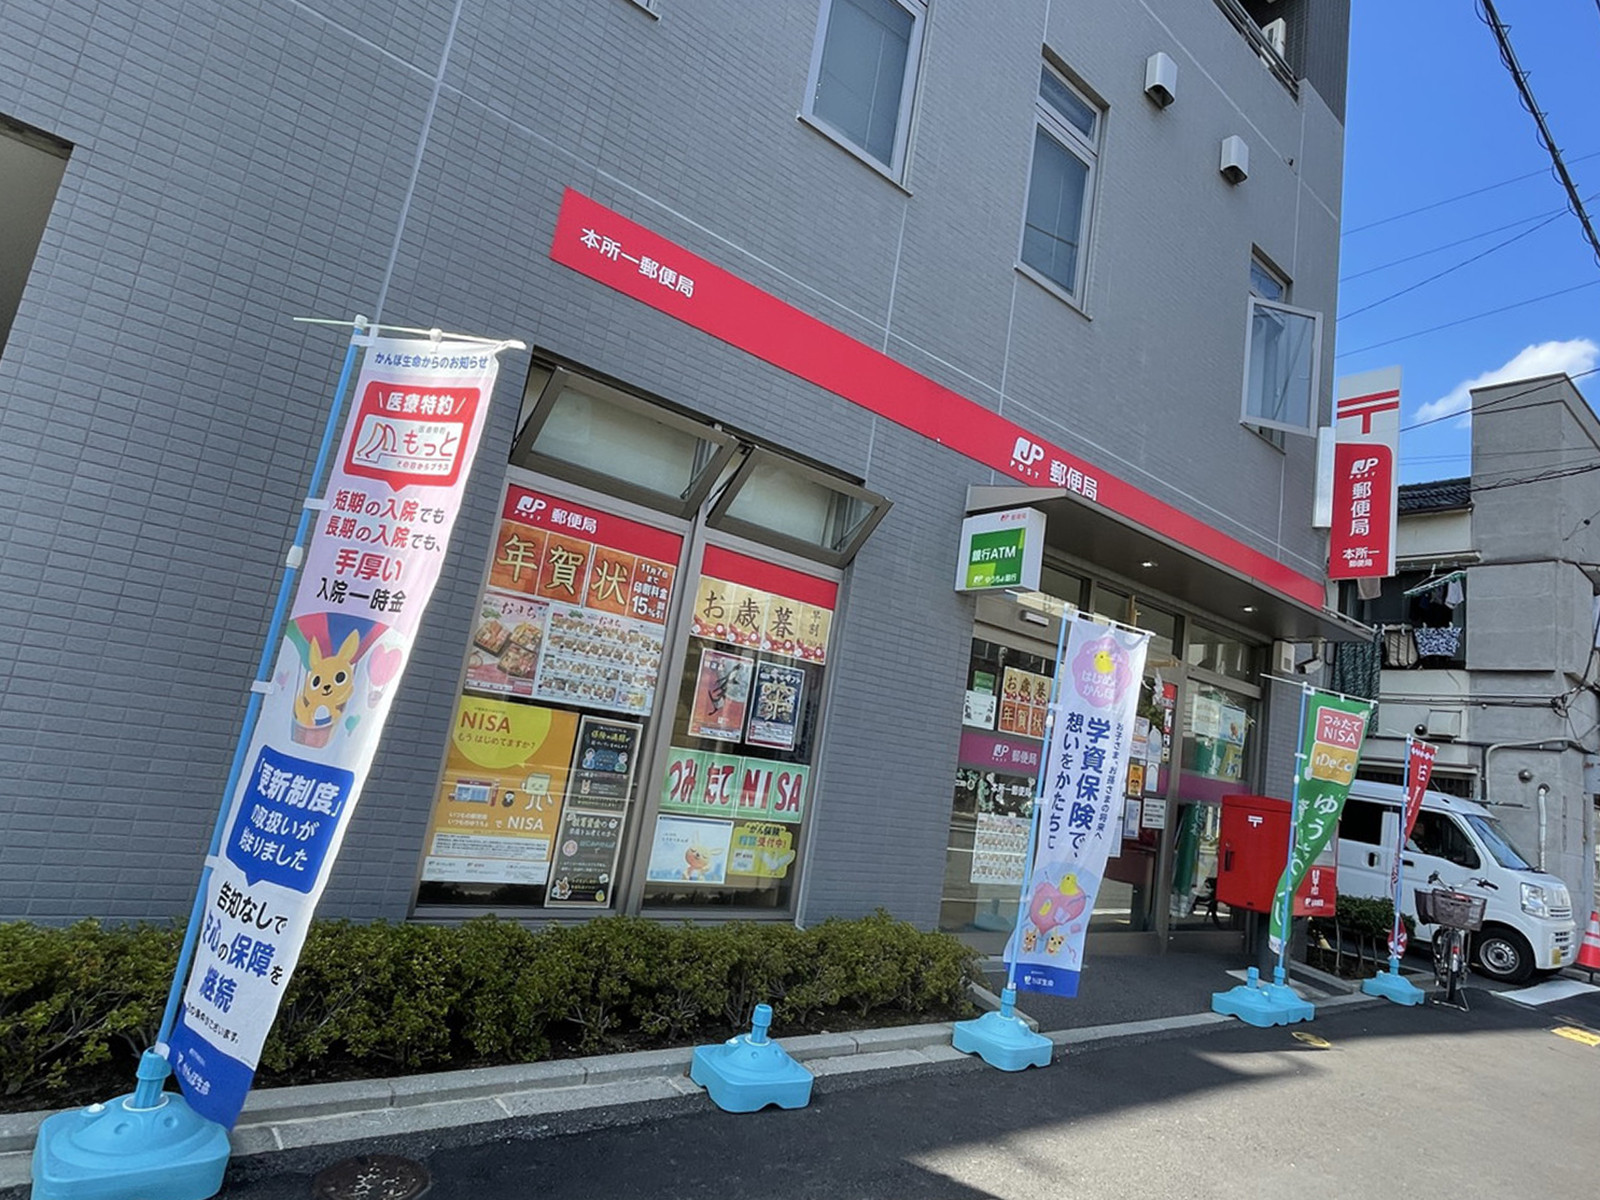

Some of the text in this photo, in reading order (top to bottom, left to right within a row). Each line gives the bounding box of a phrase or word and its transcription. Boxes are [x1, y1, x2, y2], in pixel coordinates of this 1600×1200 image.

[579, 227, 695, 298] 本所一郵便局
[374, 352, 488, 369] かんぽ生命からのお知らせ
[386, 391, 454, 415] 医療特約
[403, 429, 457, 456] もっと
[1009, 460, 1040, 479] POST
[1049, 459, 1098, 501] 郵便局
[333, 489, 444, 523] 短期の入院でも
[1350, 481, 1372, 536] 郵便局
[324, 515, 442, 552] 長期の入院でも、
[550, 508, 597, 534] 郵便局
[335, 548, 402, 581] 手厚い
[971, 545, 1016, 562] 銀行ATM
[1343, 547, 1380, 559] 本所一
[496, 533, 628, 606] 年賀状
[316, 577, 407, 613] 入院一時金
[634, 581, 668, 600] 印刷料金
[703, 590, 794, 639] お歳暮
[460, 711, 511, 734] NISA
[1002, 706, 1043, 732] 年賀状
[1323, 715, 1362, 732] つみたて
[1323, 726, 1357, 745] NISA
[1012, 750, 1037, 766] 郵便局
[1316, 753, 1353, 772] iDeCo
[258, 757, 342, 817] 「更新制度」
[1047, 712, 1085, 849] 想いをかたちに
[1068, 716, 1111, 858] 学資保険で、
[507, 815, 543, 831] NISA
[217, 881, 288, 935] 告知なしで
[199, 964, 238, 1013] 継続
